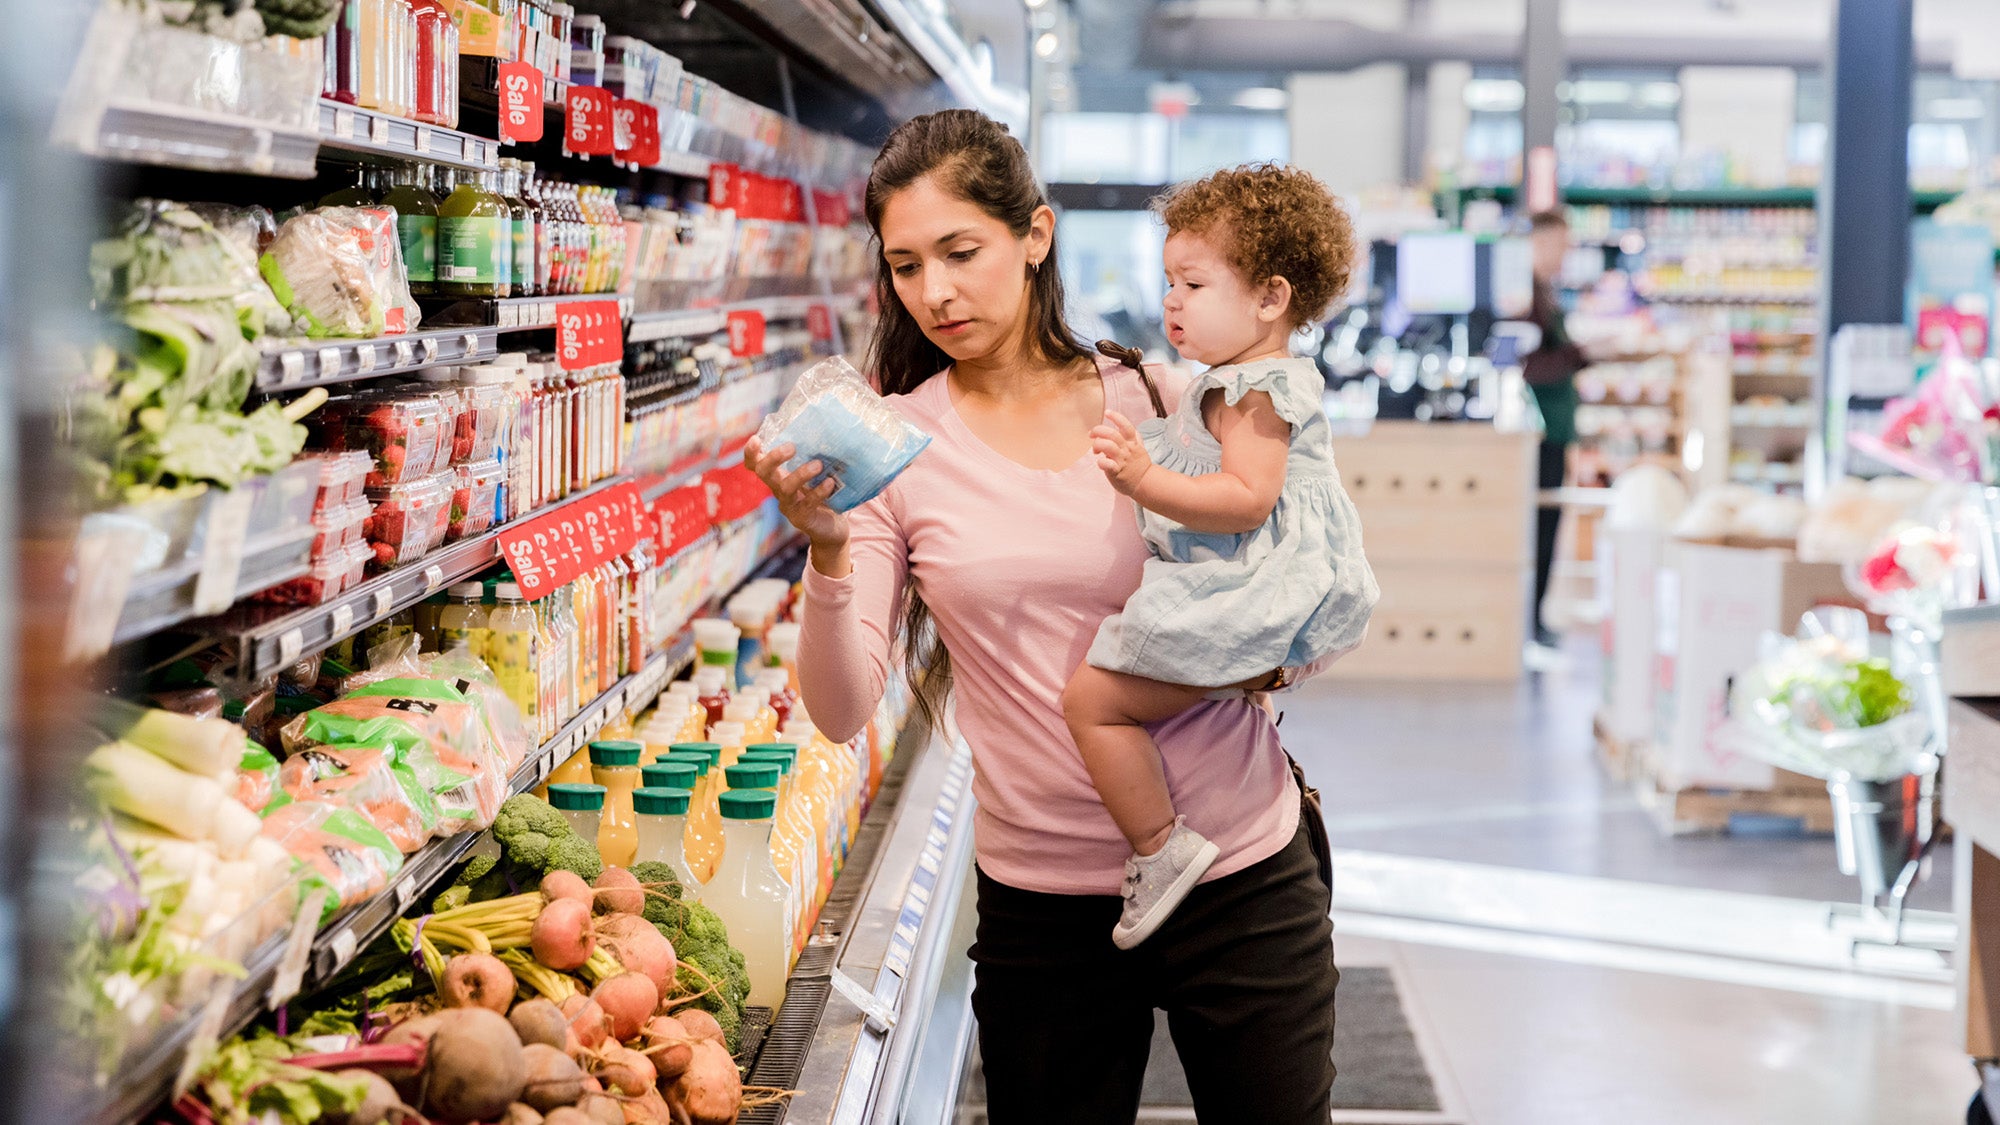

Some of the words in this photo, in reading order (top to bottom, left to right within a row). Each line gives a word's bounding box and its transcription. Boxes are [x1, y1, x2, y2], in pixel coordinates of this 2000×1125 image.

[506, 75, 530, 125] Sale
[571, 95, 592, 142] Sale
[561, 313, 582, 360] Sale
[508, 539, 542, 588] Sale
